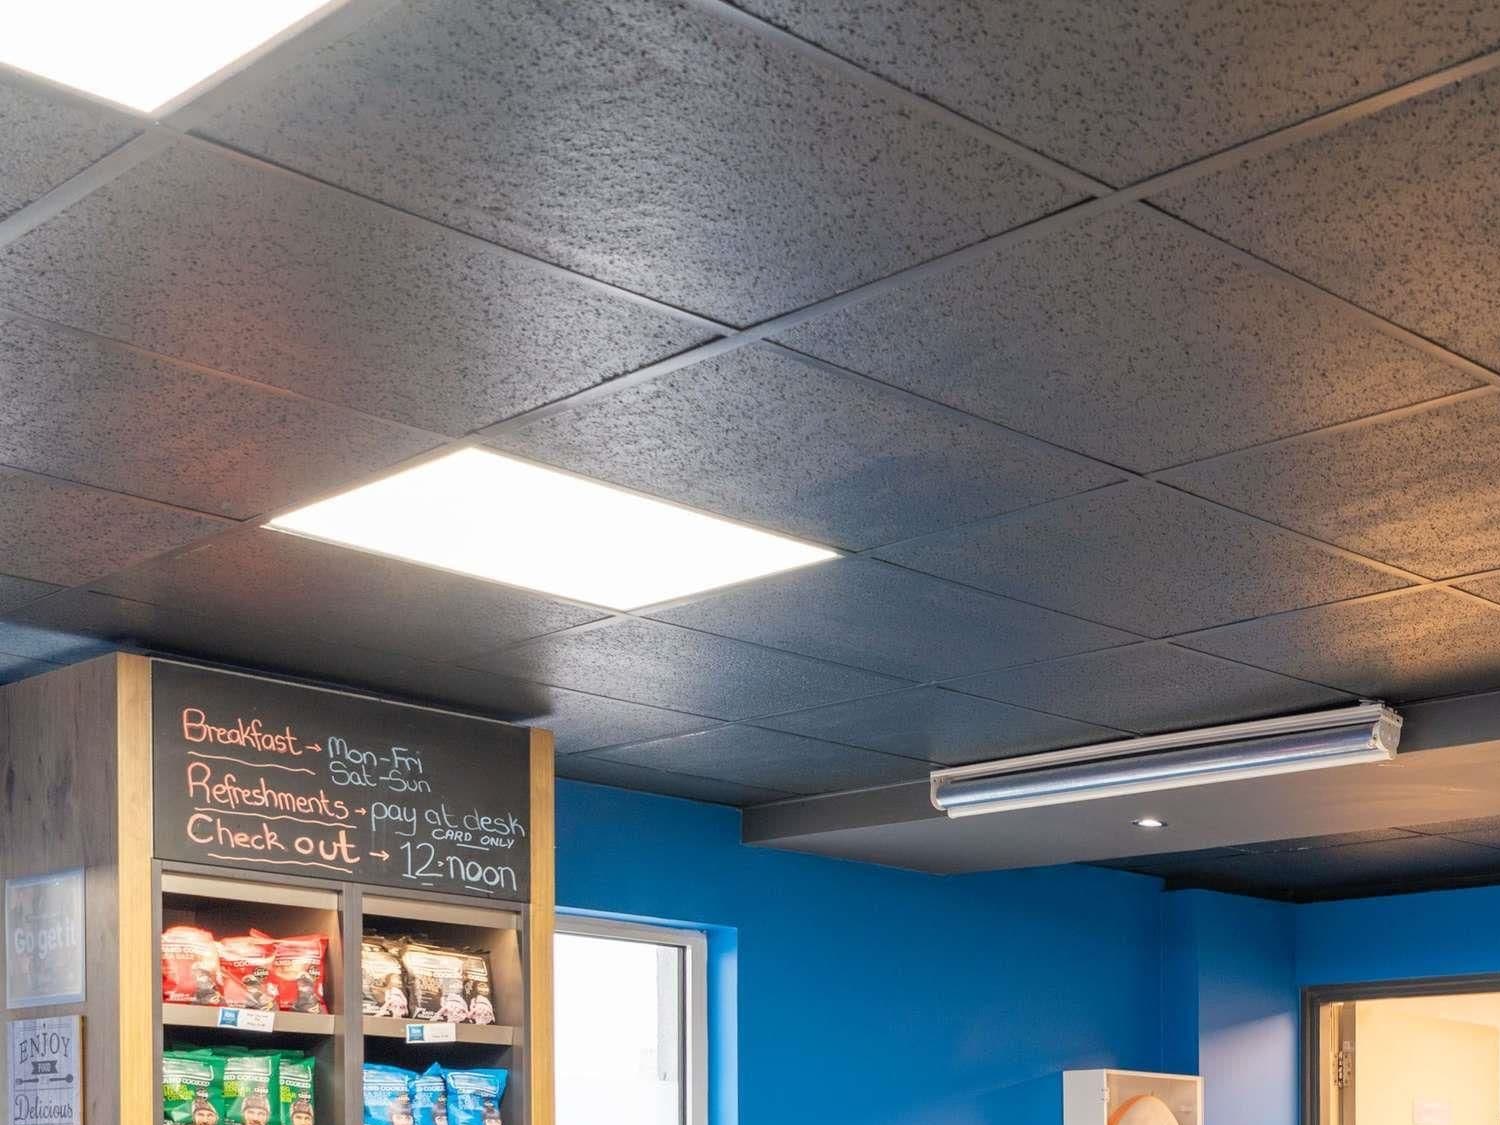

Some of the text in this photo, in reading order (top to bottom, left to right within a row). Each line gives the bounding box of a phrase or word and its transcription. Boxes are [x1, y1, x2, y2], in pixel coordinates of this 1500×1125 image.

[183, 708, 302, 755] Breakfast
[187, 762, 526, 837] Refreshments pay at desk
[187, 813, 518, 891] Check out 12 noon
[432, 828, 515, 849] CARD ONLY
[19, 1032, 70, 1064] ENJOY
[14, 1094, 72, 1121] Delicious
